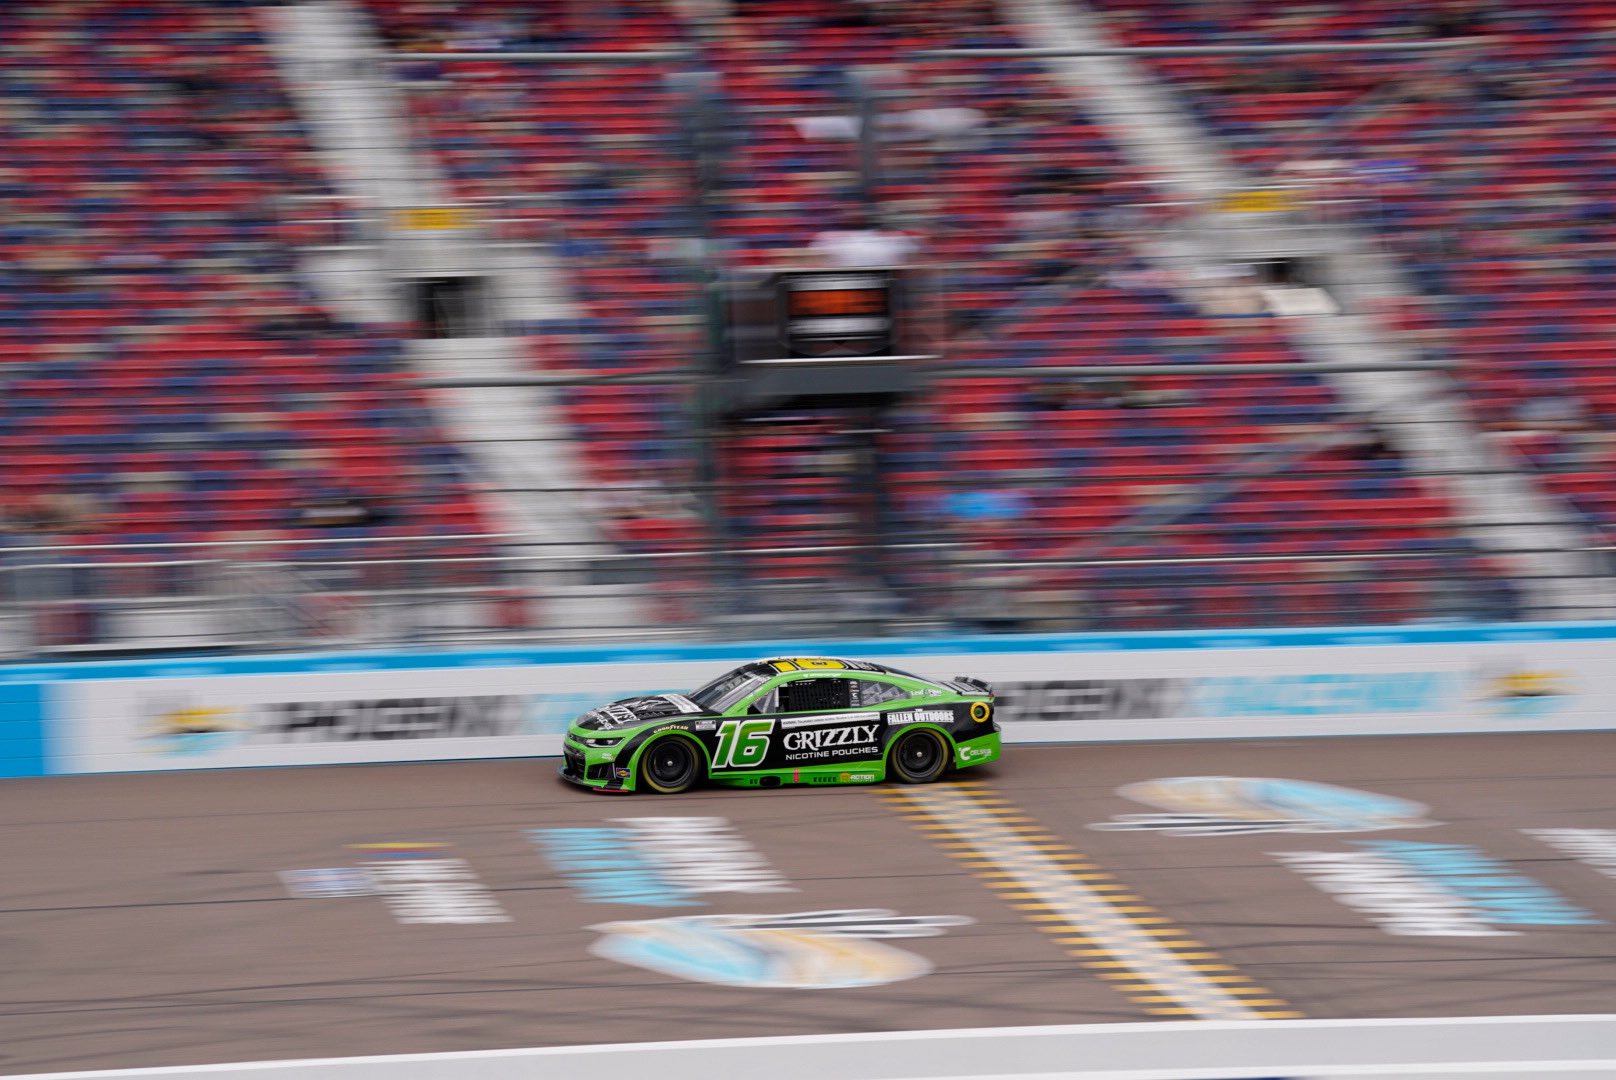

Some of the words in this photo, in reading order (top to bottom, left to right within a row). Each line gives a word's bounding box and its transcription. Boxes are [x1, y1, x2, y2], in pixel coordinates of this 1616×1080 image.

[887, 712, 914, 725] FALLEN
[653, 724, 689, 734] GOODYEAR
[711, 718, 776, 769] 16
[783, 724, 880, 751] GRIZZLY
[785, 750, 830, 761] NICOTINE
[832, 746, 879, 757] POUCHES
